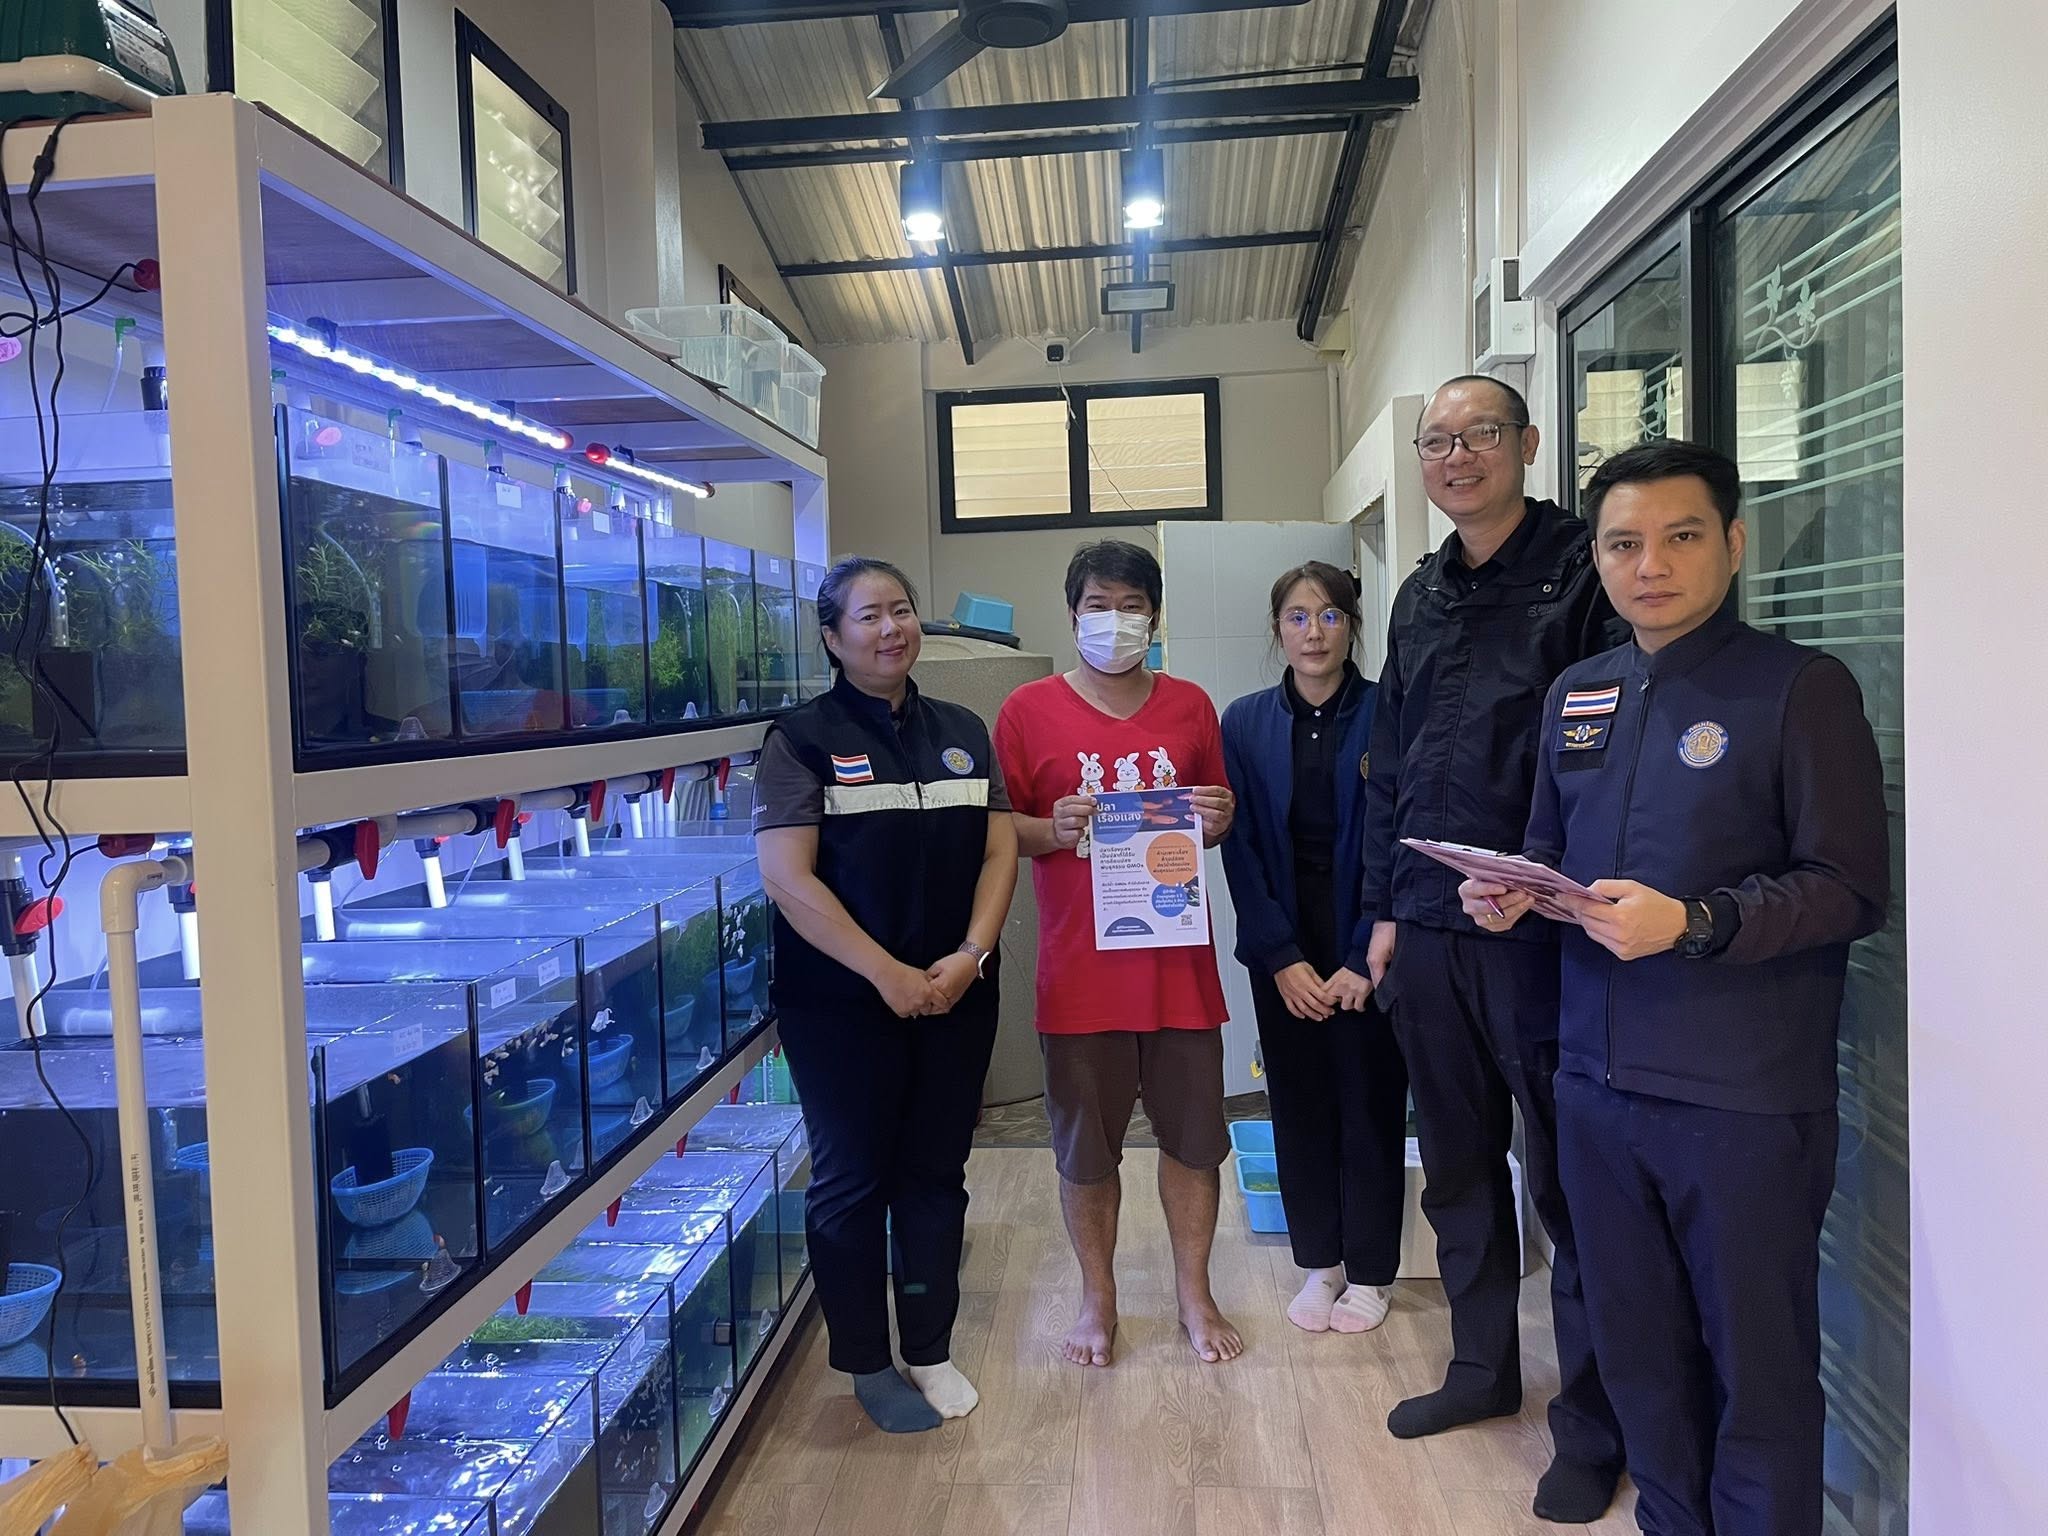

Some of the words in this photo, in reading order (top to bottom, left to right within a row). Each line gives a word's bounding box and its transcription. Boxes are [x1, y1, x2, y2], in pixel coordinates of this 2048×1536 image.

[1096, 802, 1116, 812] ปลา
[1097, 812, 1141, 823] เรืองแสง
